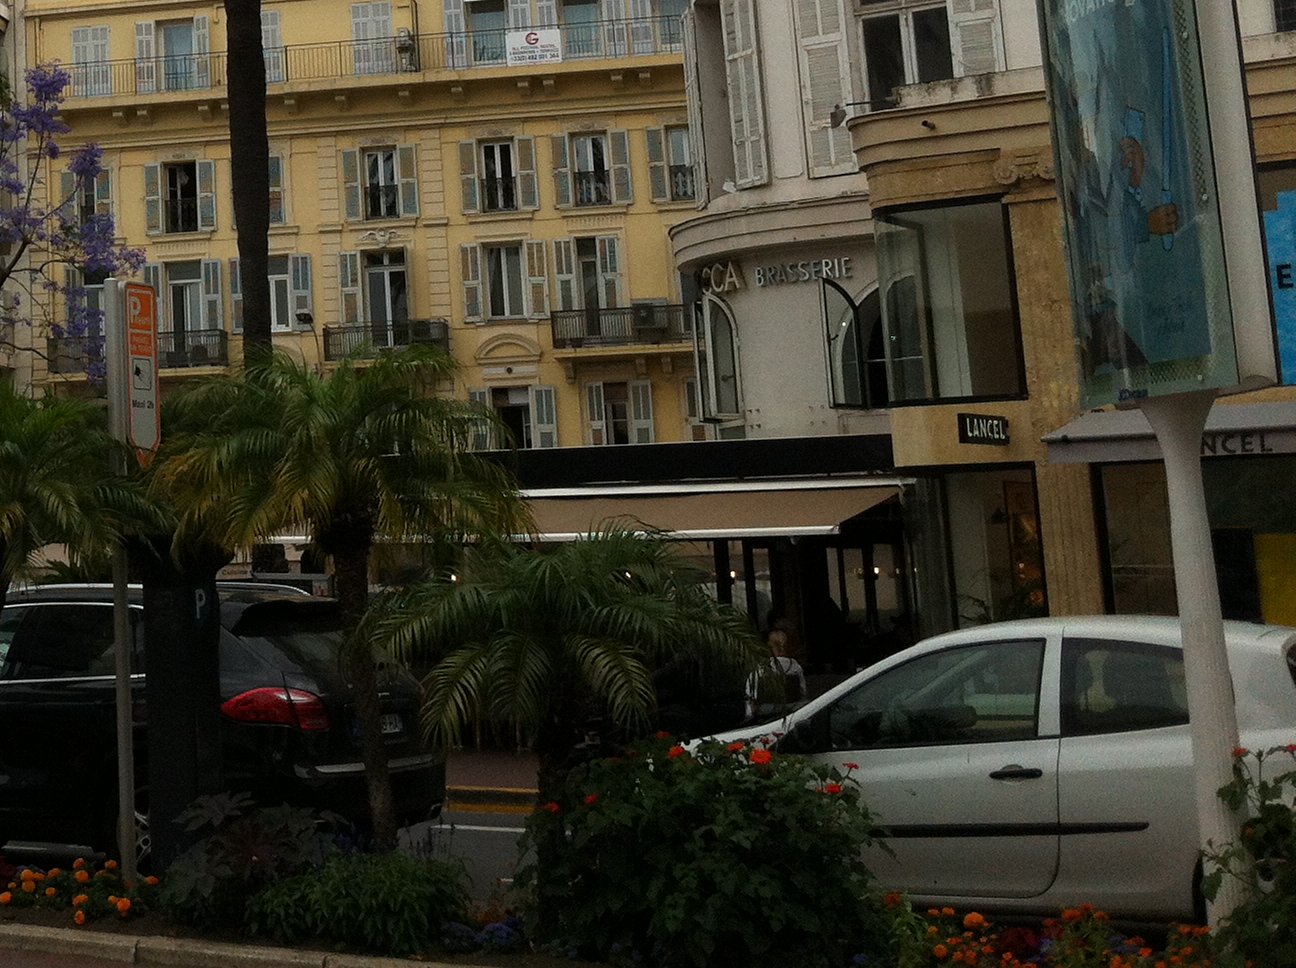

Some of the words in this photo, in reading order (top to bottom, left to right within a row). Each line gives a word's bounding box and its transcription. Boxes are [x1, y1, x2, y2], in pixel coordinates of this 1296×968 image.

[700, 261, 740, 294] CCA
[755, 257, 852, 287] BRASSERIE
[966, 417, 1006, 440] LANCEL
[1200, 431, 1273, 455] NCEL
